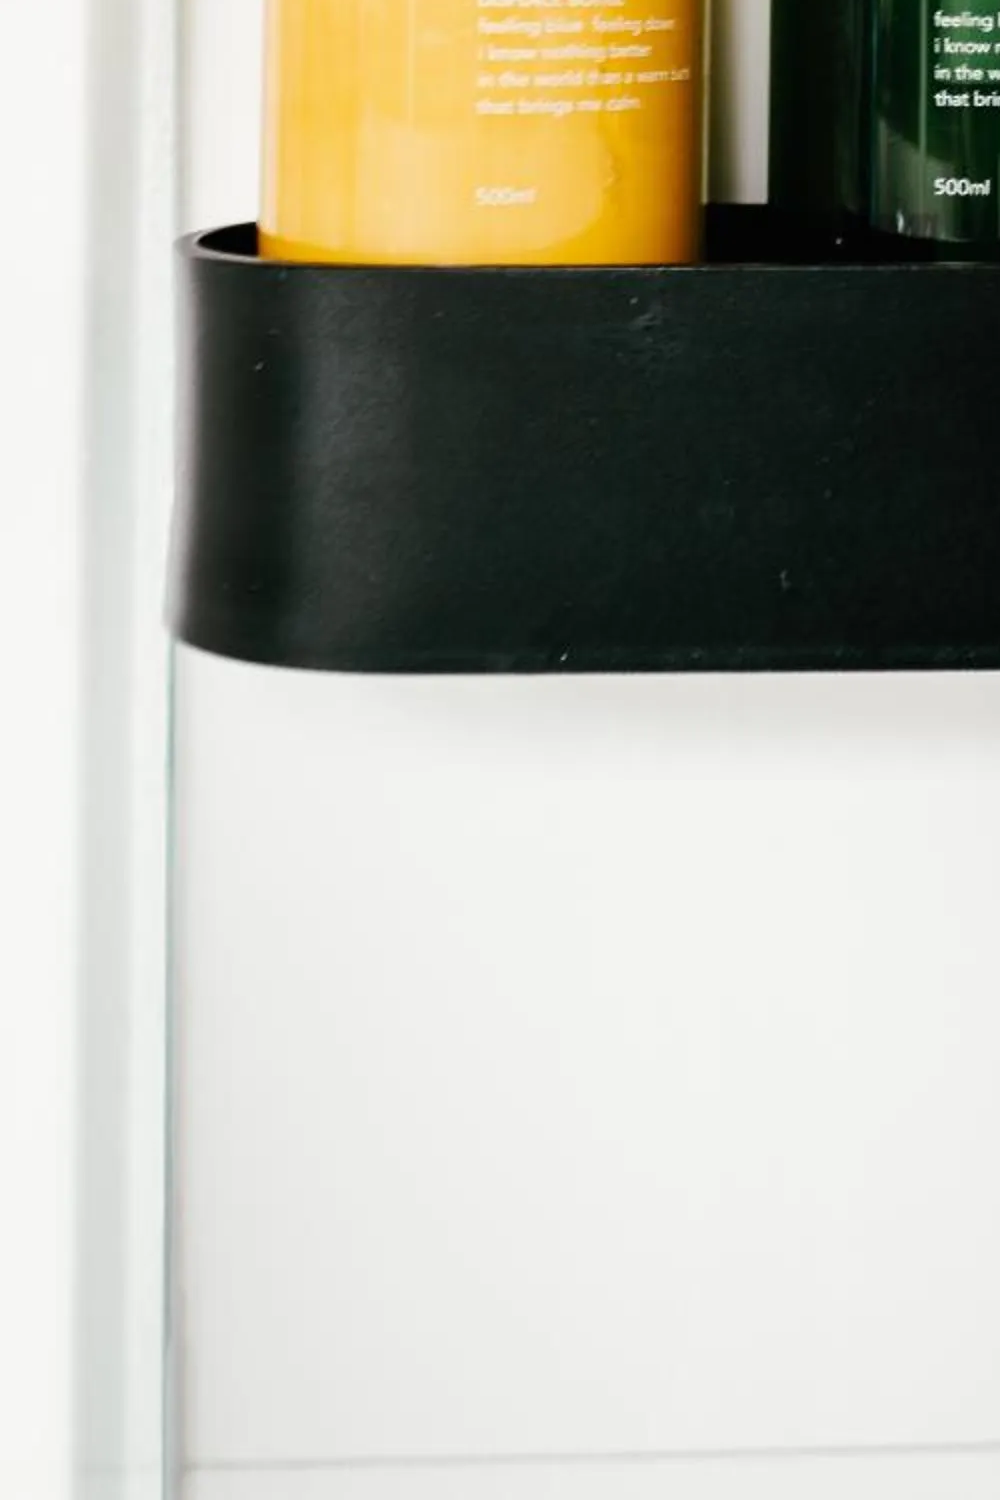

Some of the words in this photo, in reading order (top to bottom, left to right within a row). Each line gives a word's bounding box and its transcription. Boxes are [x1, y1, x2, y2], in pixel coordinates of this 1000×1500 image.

[933, 10, 994, 33] feeling
[934, 37, 940, 53] i
[943, 37, 991, 54] know
[933, 64, 951, 81] in
[955, 63, 984, 81] the
[934, 90, 969, 107] that
[933, 177, 990, 197] 500ml
